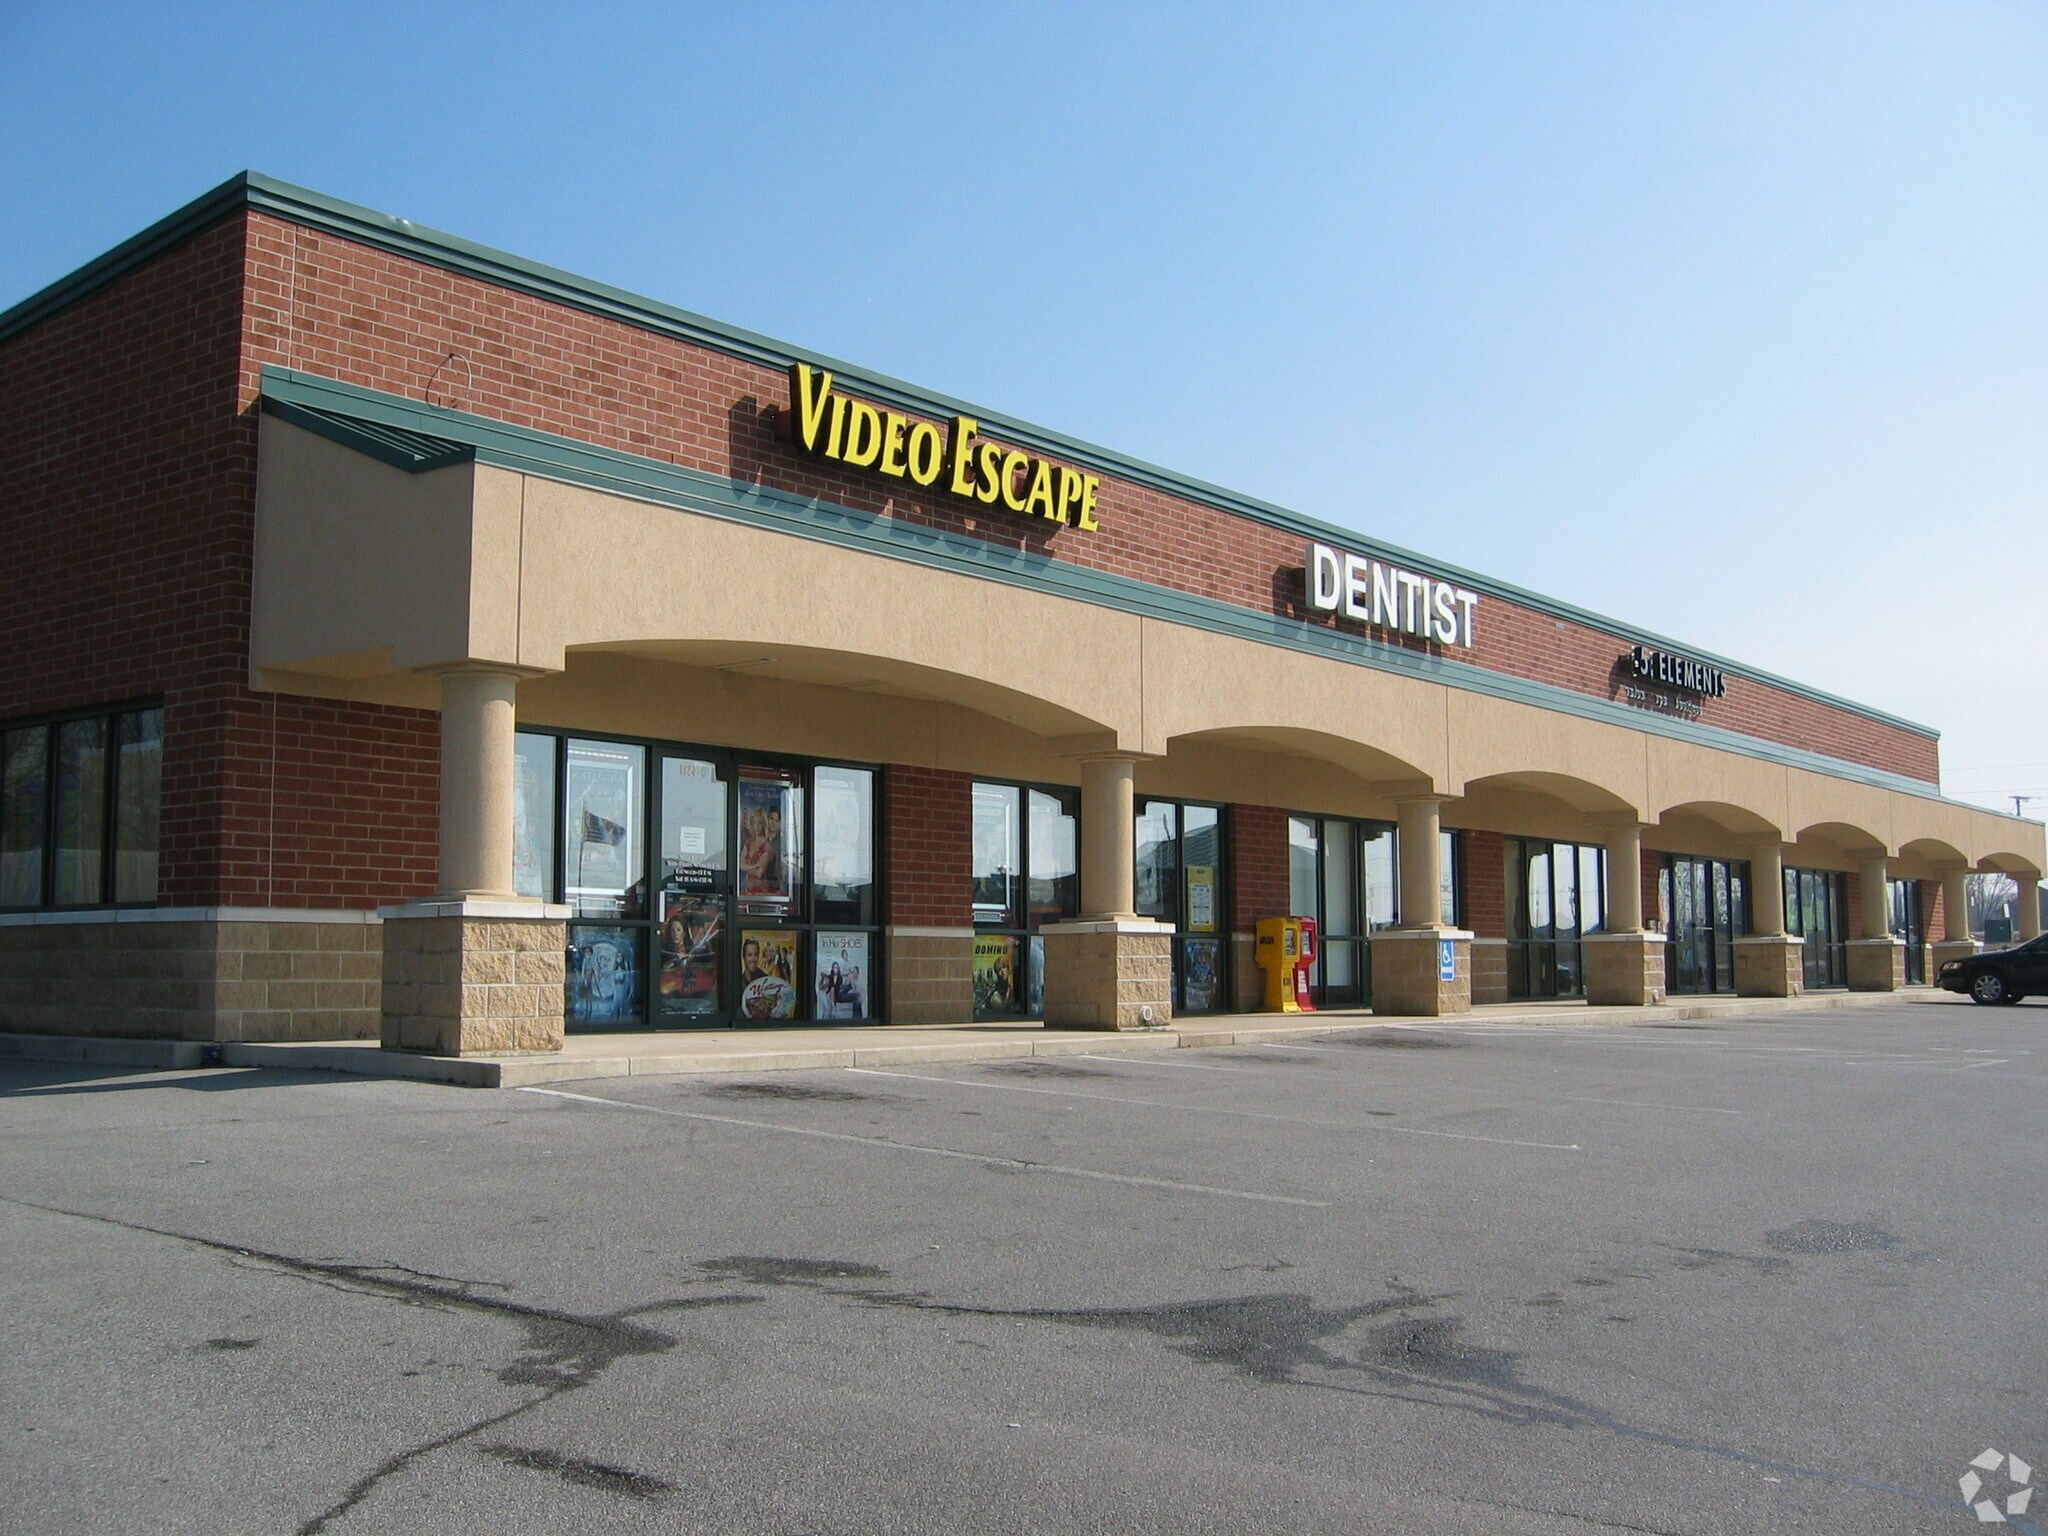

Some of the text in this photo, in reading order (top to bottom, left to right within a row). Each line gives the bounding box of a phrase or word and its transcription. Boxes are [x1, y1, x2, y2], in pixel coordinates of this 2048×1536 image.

[793, 361, 1101, 532] VIDEO ESCAPE
[1309, 543, 1478, 649] DENTIST
[1658, 652, 1728, 698] ELEMENTS
[975, 944, 1008, 955] DOMINO
